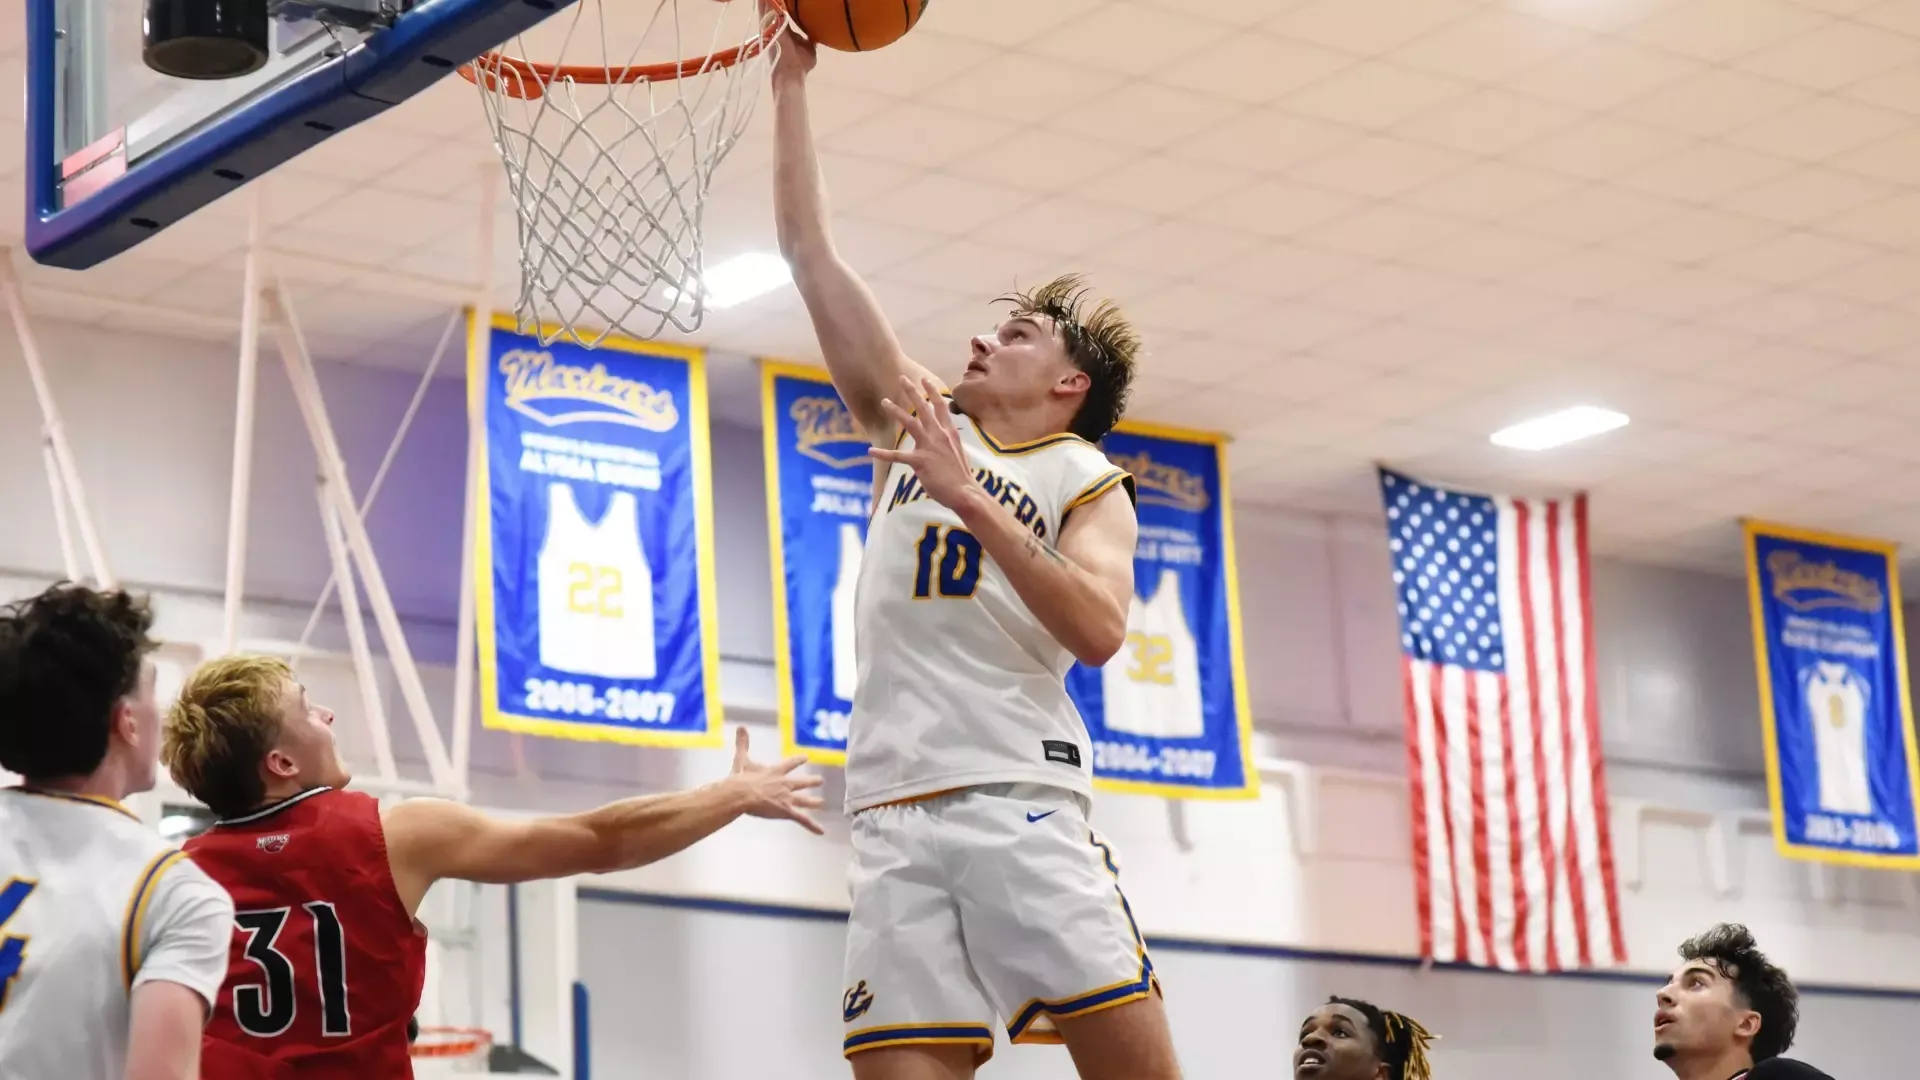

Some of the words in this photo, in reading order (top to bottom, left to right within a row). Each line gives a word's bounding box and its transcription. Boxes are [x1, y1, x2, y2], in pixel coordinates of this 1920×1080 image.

[568, 561, 624, 618] 22
[913, 522, 985, 601] 10
[1125, 631, 1174, 684] 32
[232, 901, 351, 1038] 31
